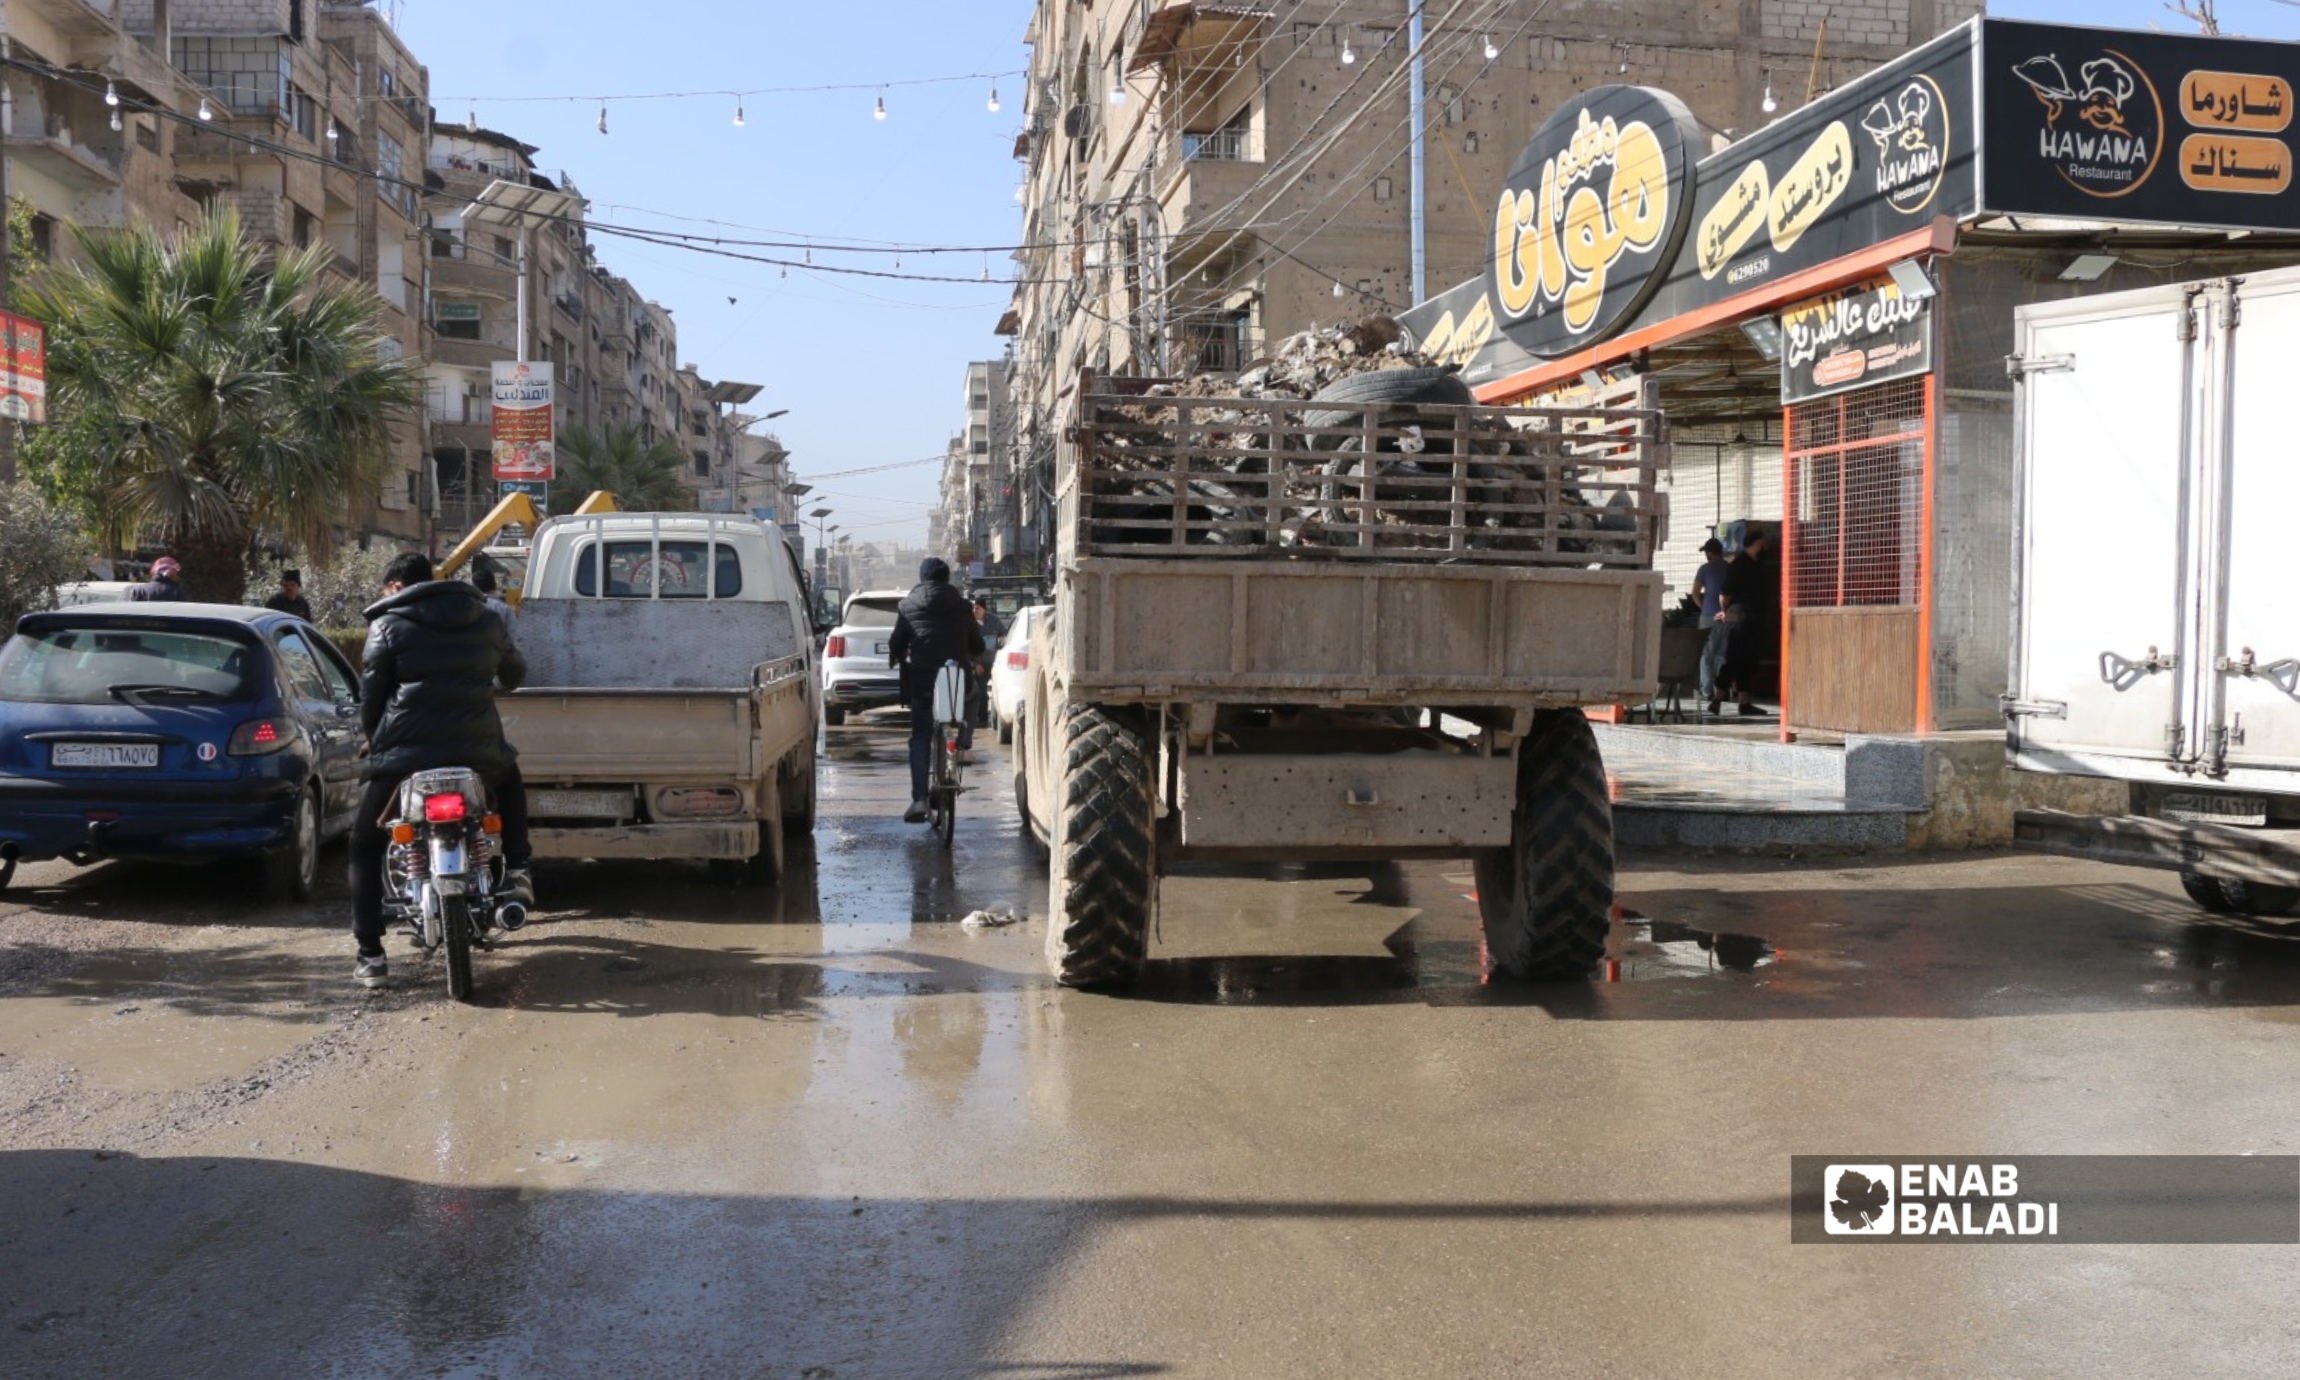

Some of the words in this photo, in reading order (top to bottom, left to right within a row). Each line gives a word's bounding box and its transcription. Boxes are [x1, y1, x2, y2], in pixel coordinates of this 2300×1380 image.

[2191, 79, 2283, 122] شاورما
[2040, 128, 2148, 164] HAWANA
[2191, 144, 2281, 180] سناك
[1778, 142, 1844, 233] بروستد
[1876, 144, 1940, 193] HAWANA
[2069, 163, 2132, 182] Restaurant
[1893, 180, 1932, 202] Restaurant
[1496, 120, 1669, 334] هوانا
[1704, 179, 1761, 271] مشوي
